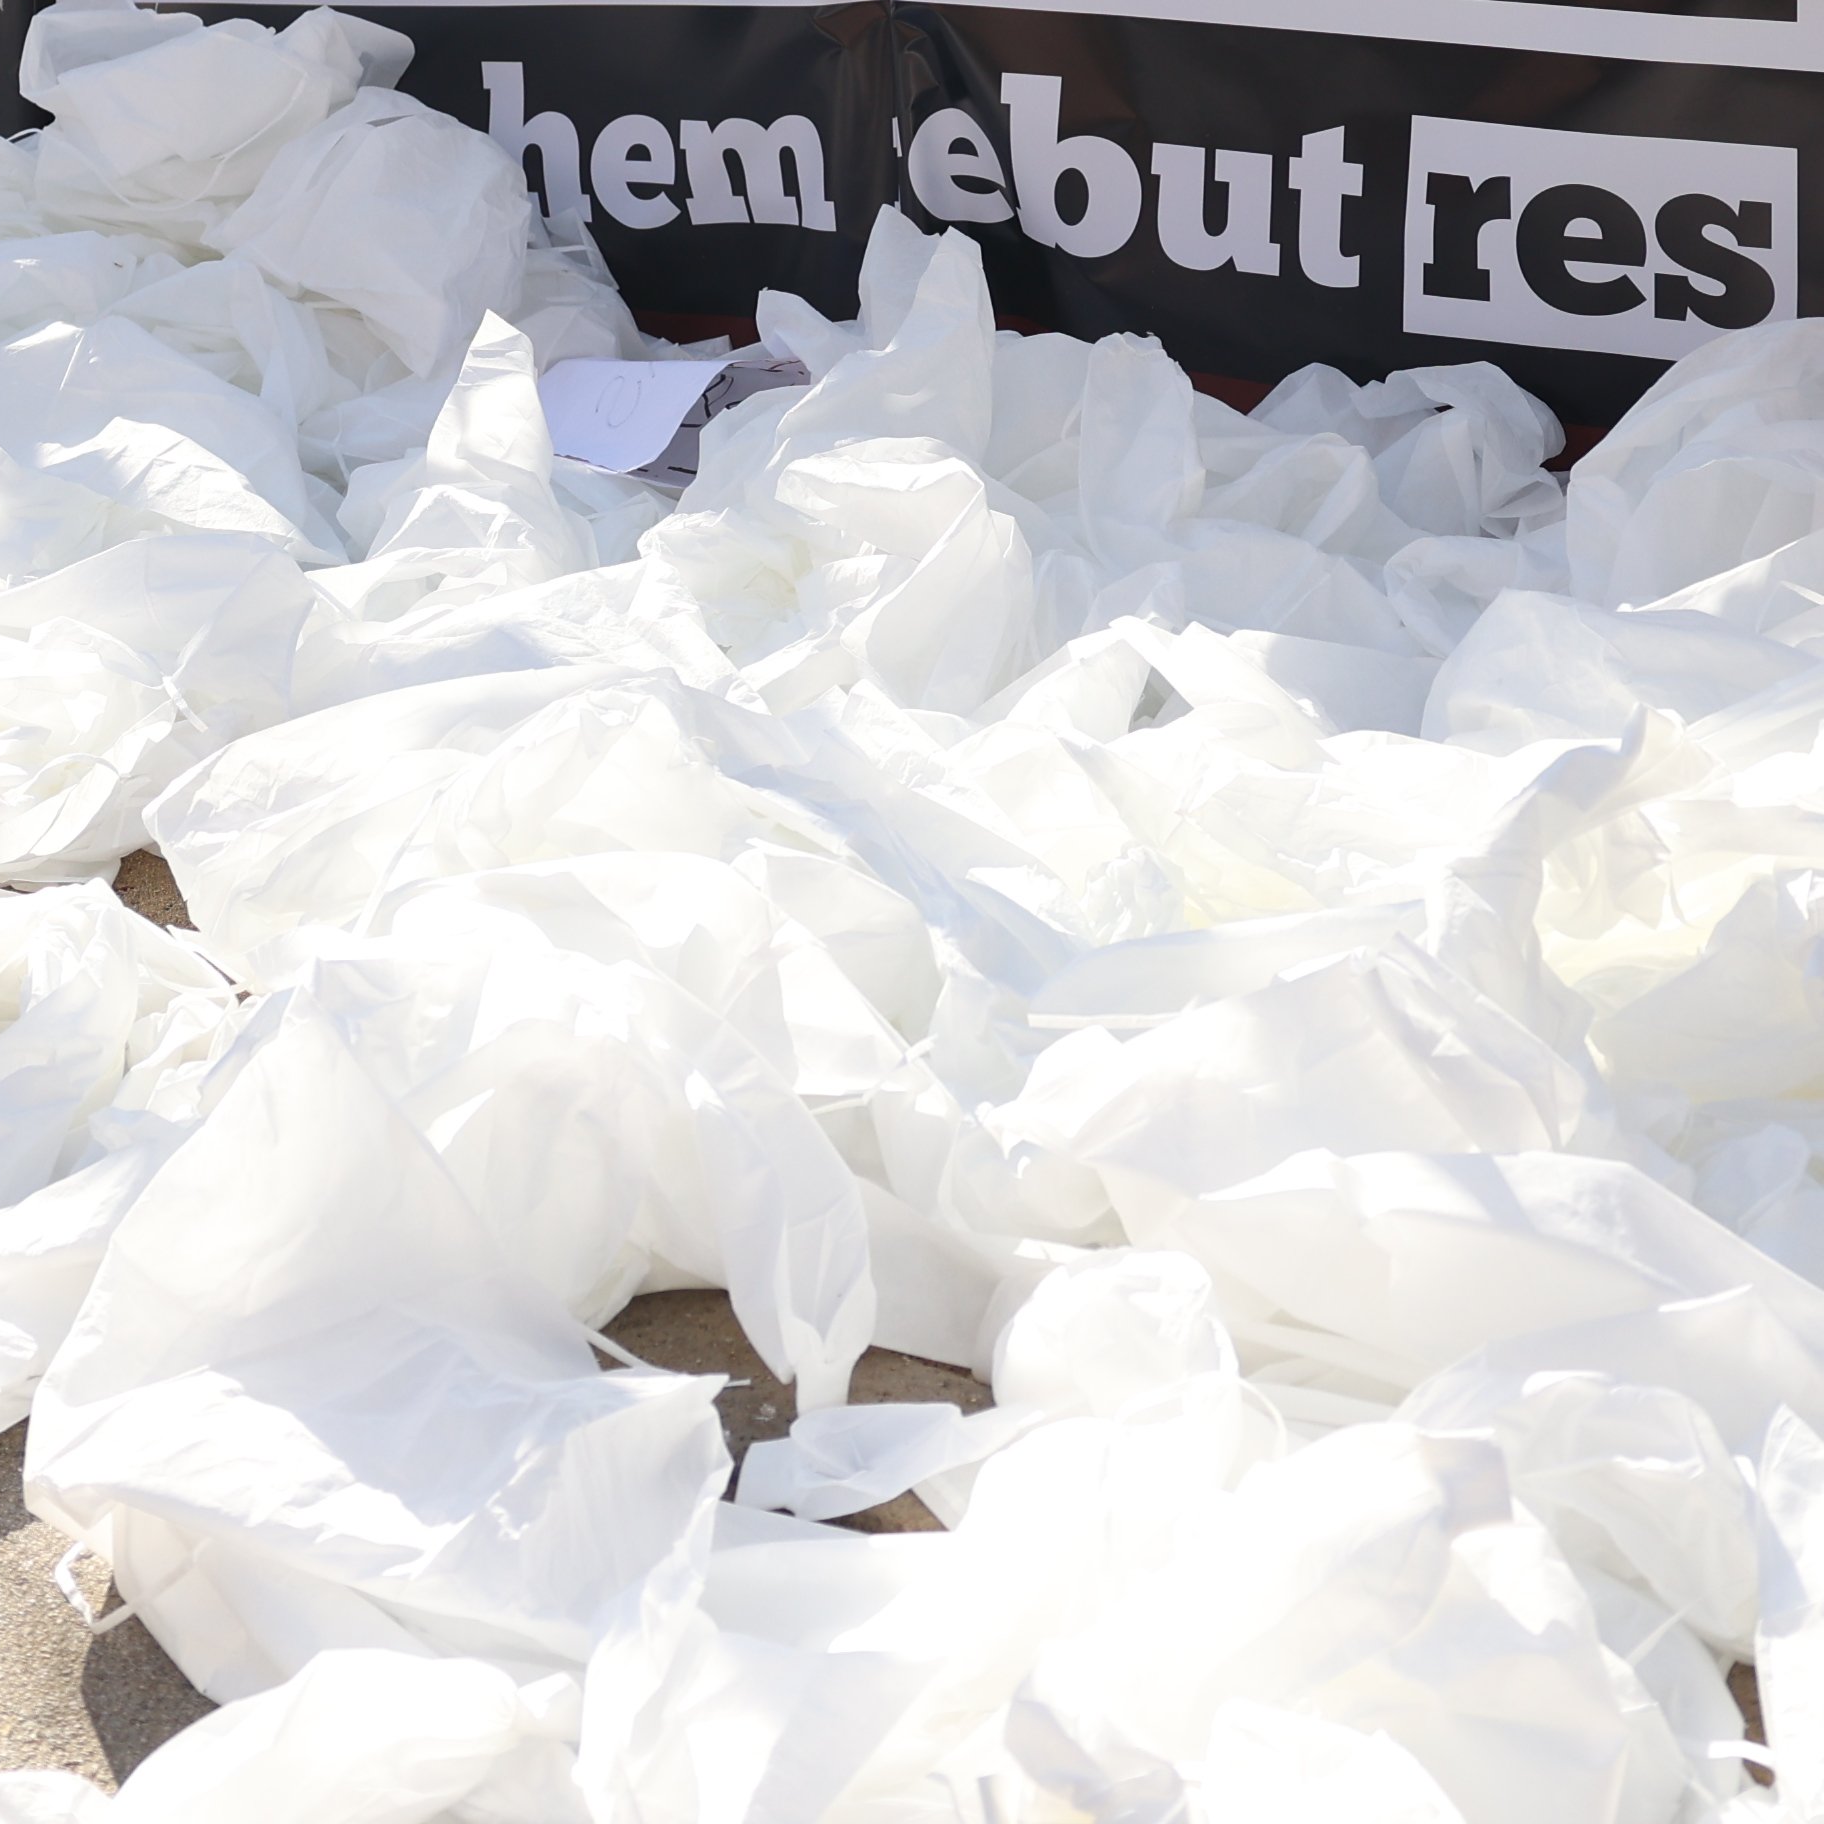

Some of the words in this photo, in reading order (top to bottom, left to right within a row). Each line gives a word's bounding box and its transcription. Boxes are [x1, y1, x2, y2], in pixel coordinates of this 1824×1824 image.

[480, 60, 836, 233] hem
[890, 72, 1363, 290] ebut
[1420, 170, 1776, 331] res
